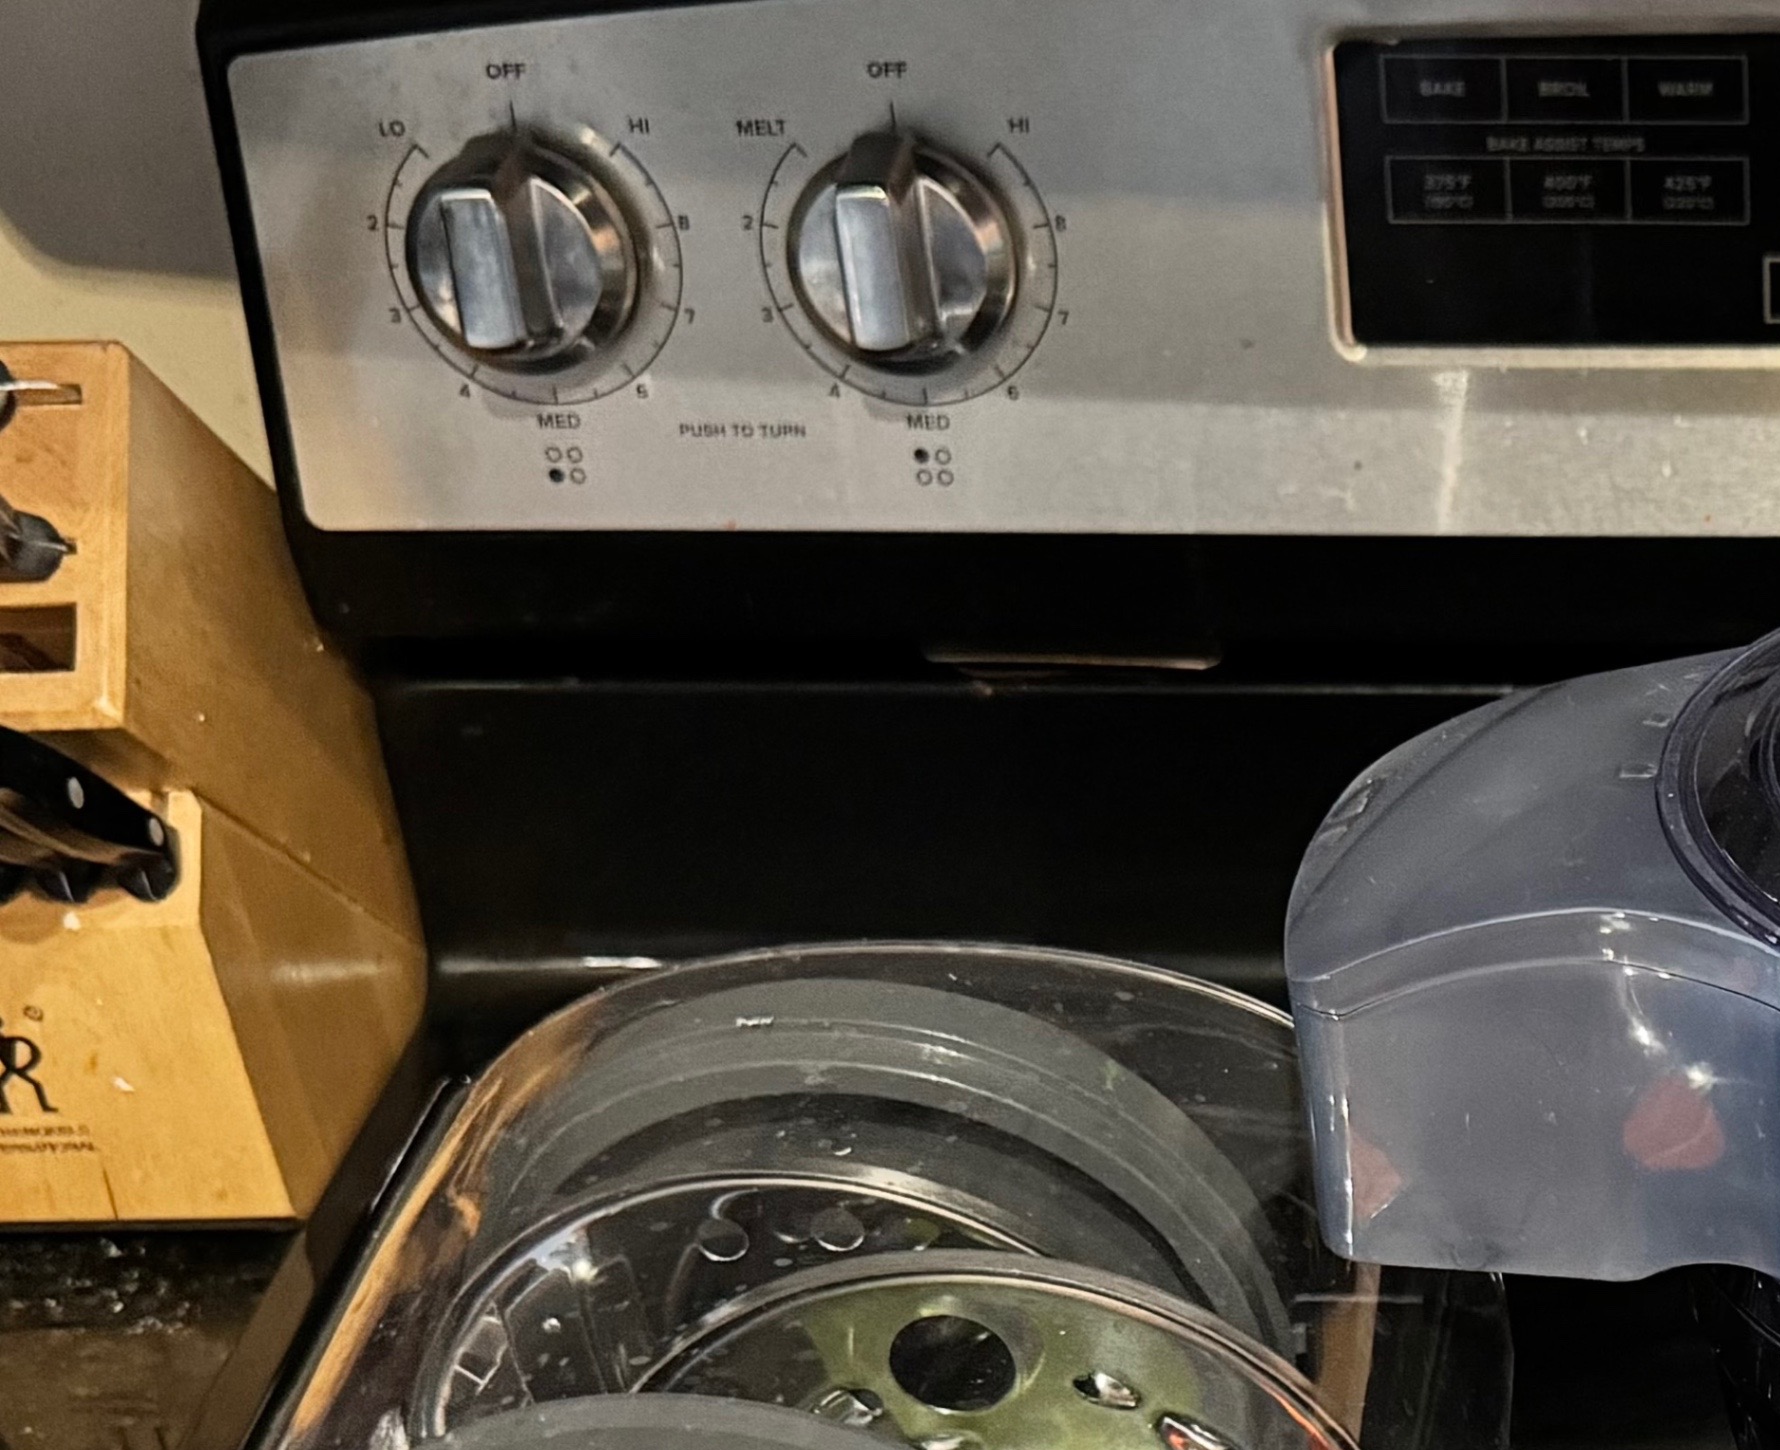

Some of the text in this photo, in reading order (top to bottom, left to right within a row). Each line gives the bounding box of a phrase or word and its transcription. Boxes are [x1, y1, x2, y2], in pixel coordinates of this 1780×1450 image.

[486, 64, 525, 79] OFF
[867, 62, 907, 78] OFF
[379, 120, 405, 136] LO
[629, 117, 649, 133] HI
[736, 120, 785, 136] MELT
[1008, 118, 1030, 133] HI
[367, 215, 378, 230] 2
[742, 215, 753, 230] 2
[1055, 216, 1067, 231] 8
[389, 307, 401, 323] 3
[684, 308, 695, 323] 7
[761, 307, 773, 322] 3
[1058, 310, 1070, 325] 7
[459, 384, 471, 399] 4
[829, 383, 841, 398] 4
[537, 413, 581, 429] MED
[907, 414, 950, 430] MED
[679, 423, 806, 438] PUSH TO TURN
